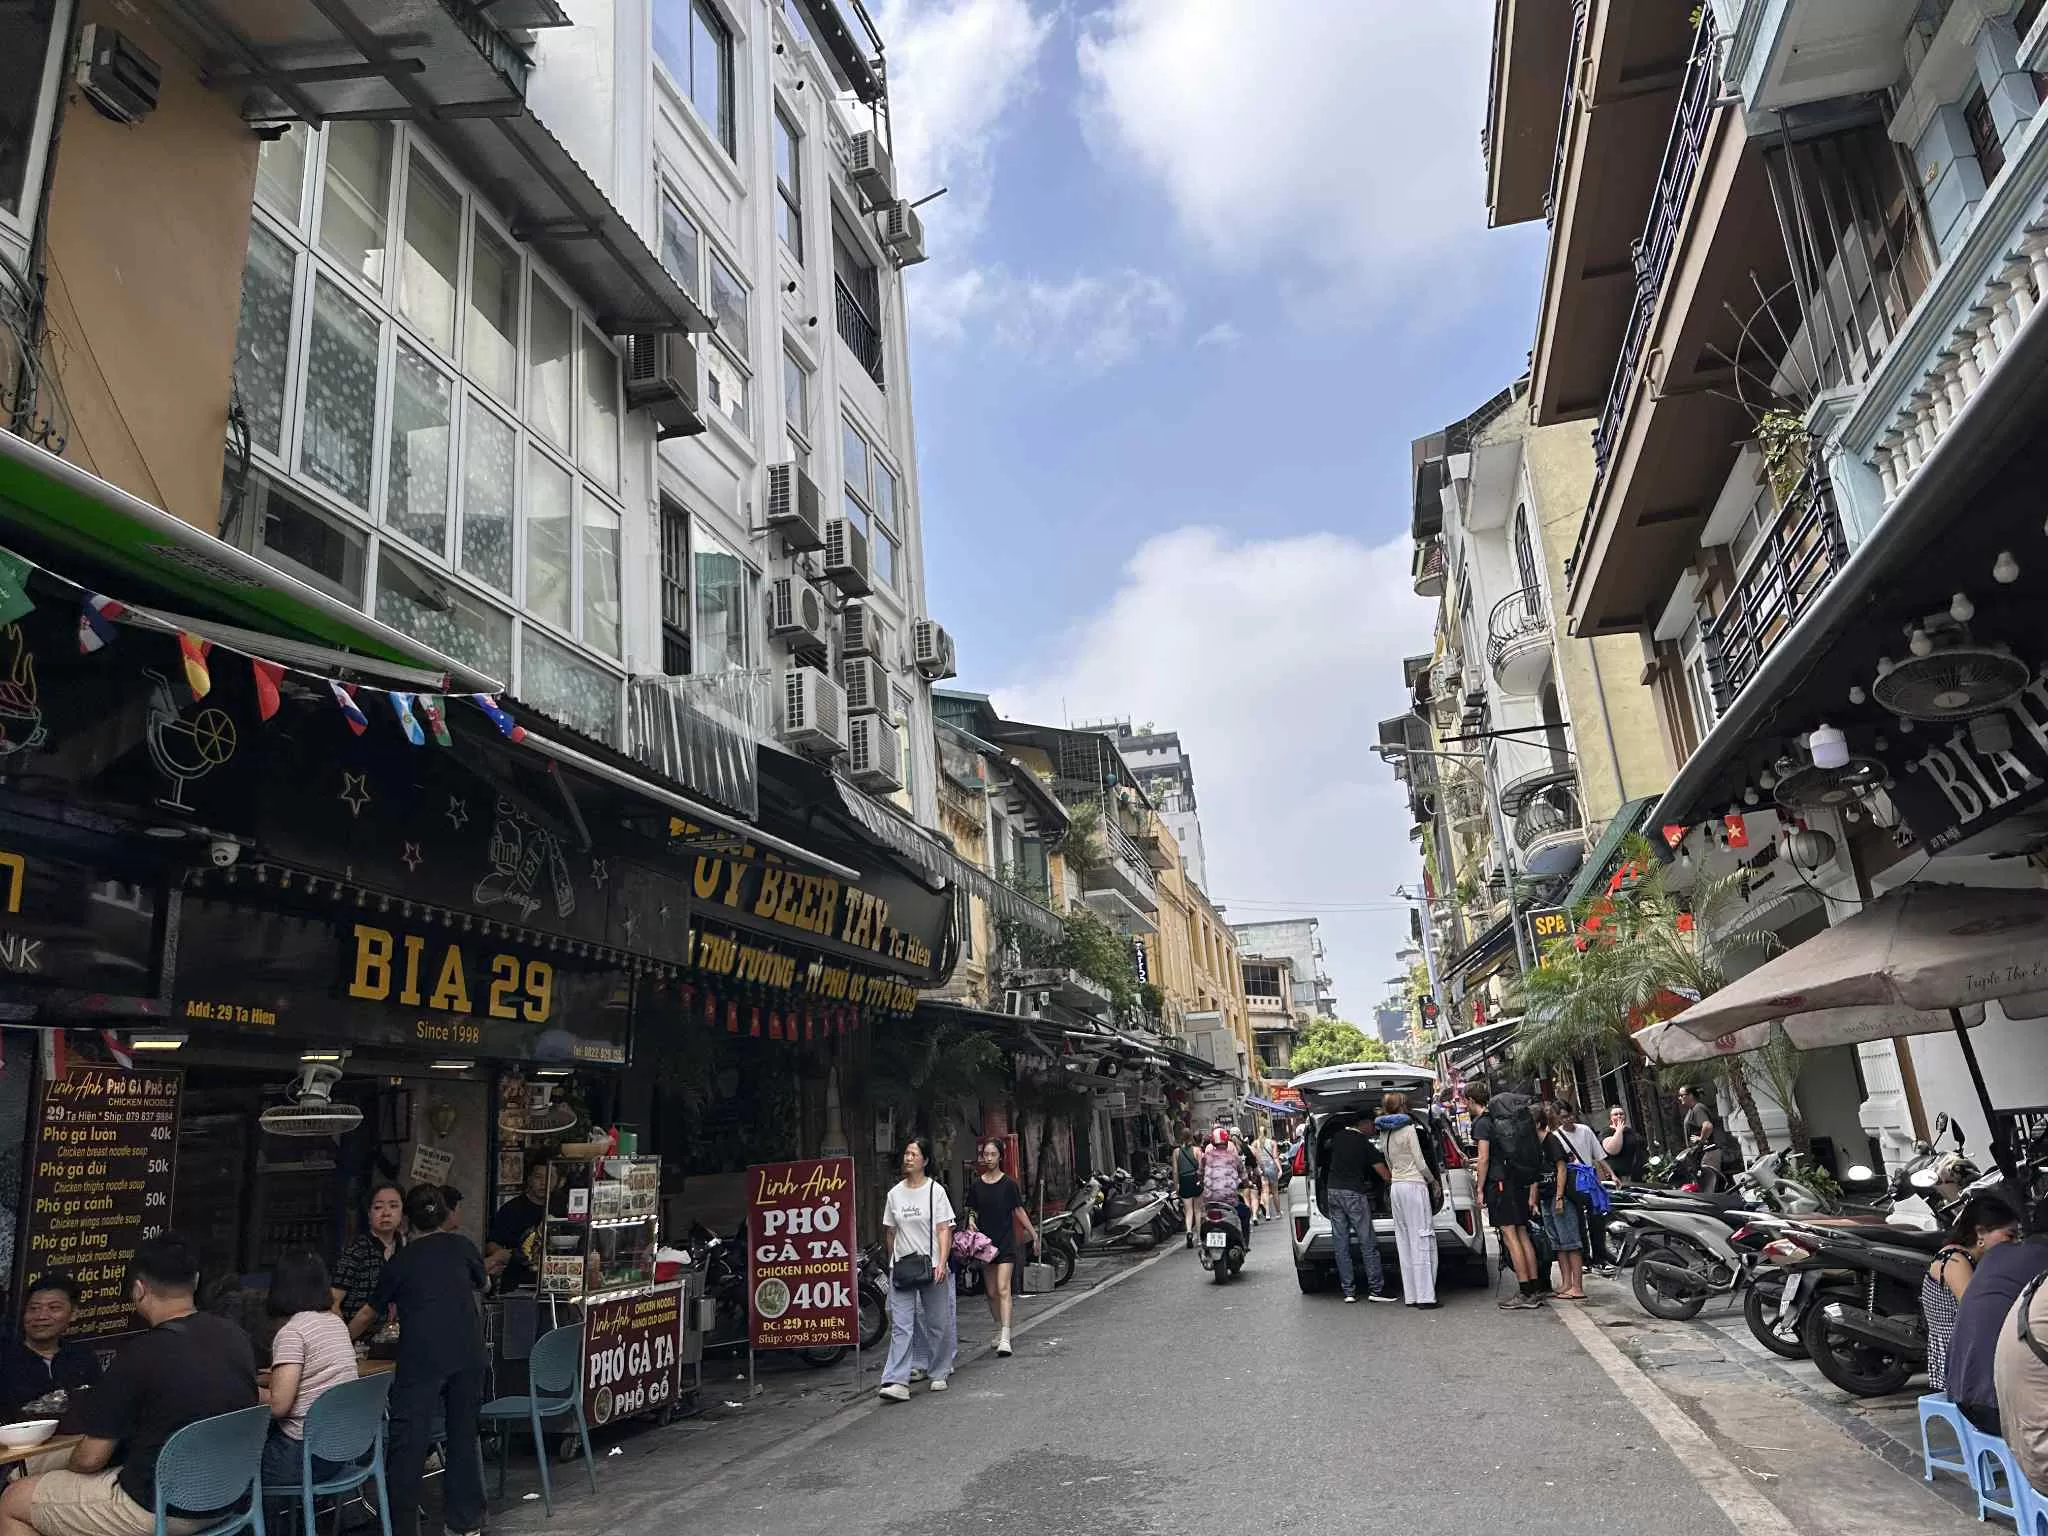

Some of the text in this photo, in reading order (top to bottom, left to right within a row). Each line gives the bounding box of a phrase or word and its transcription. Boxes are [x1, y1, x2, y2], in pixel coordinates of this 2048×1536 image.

[1918, 737, 2045, 825] BIA
[754, 853, 839, 937] BEER
[1535, 914, 1567, 935] SPA
[349, 924, 553, 1023] BIA 29
[186, 1000, 277, 1025] Add: 29 Ta Hien
[416, 1020, 480, 1044] Since 1998
[73, 1072, 104, 1104] Anh
[108, 1097, 176, 1107] CHICKEN NOODLE
[46, 1105, 65, 1121] 29
[103, 1111, 124, 1124] Ship:
[126, 1112, 140, 1121] 079
[150, 1127, 171, 1140] 40k
[57, 1146, 85, 1158] Chicken
[87, 1146, 108, 1157] breast
[109, 1146, 131, 1156] noodle
[147, 1159, 169, 1173] 50k
[54, 1182, 82, 1193] Chicken
[105, 1180, 128, 1191] noodle
[756, 1164, 847, 1205] Linh Anh
[145, 1192, 167, 1207] 50k
[50, 1217, 79, 1230] Chicken
[763, 1196, 841, 1236] PHỞ
[47, 1254, 76, 1266] Chicken
[756, 1239, 849, 1263] GÀ TA
[102, 1264, 128, 1282] biệt
[757, 1262, 849, 1277] CHICKEN NOODLE
[792, 1281, 852, 1309] 40k
[591, 1296, 676, 1341] Linh Anh CHICKEN NOODLE
[763, 1316, 845, 1331] ĐC: 29 TẠ HIỆN
[759, 1329, 851, 1345] Ship: 0798 379 884
[589, 1329, 675, 1389] PHỞ GÀ TA
[615, 1369, 669, 1416] PHỐ CỔ
